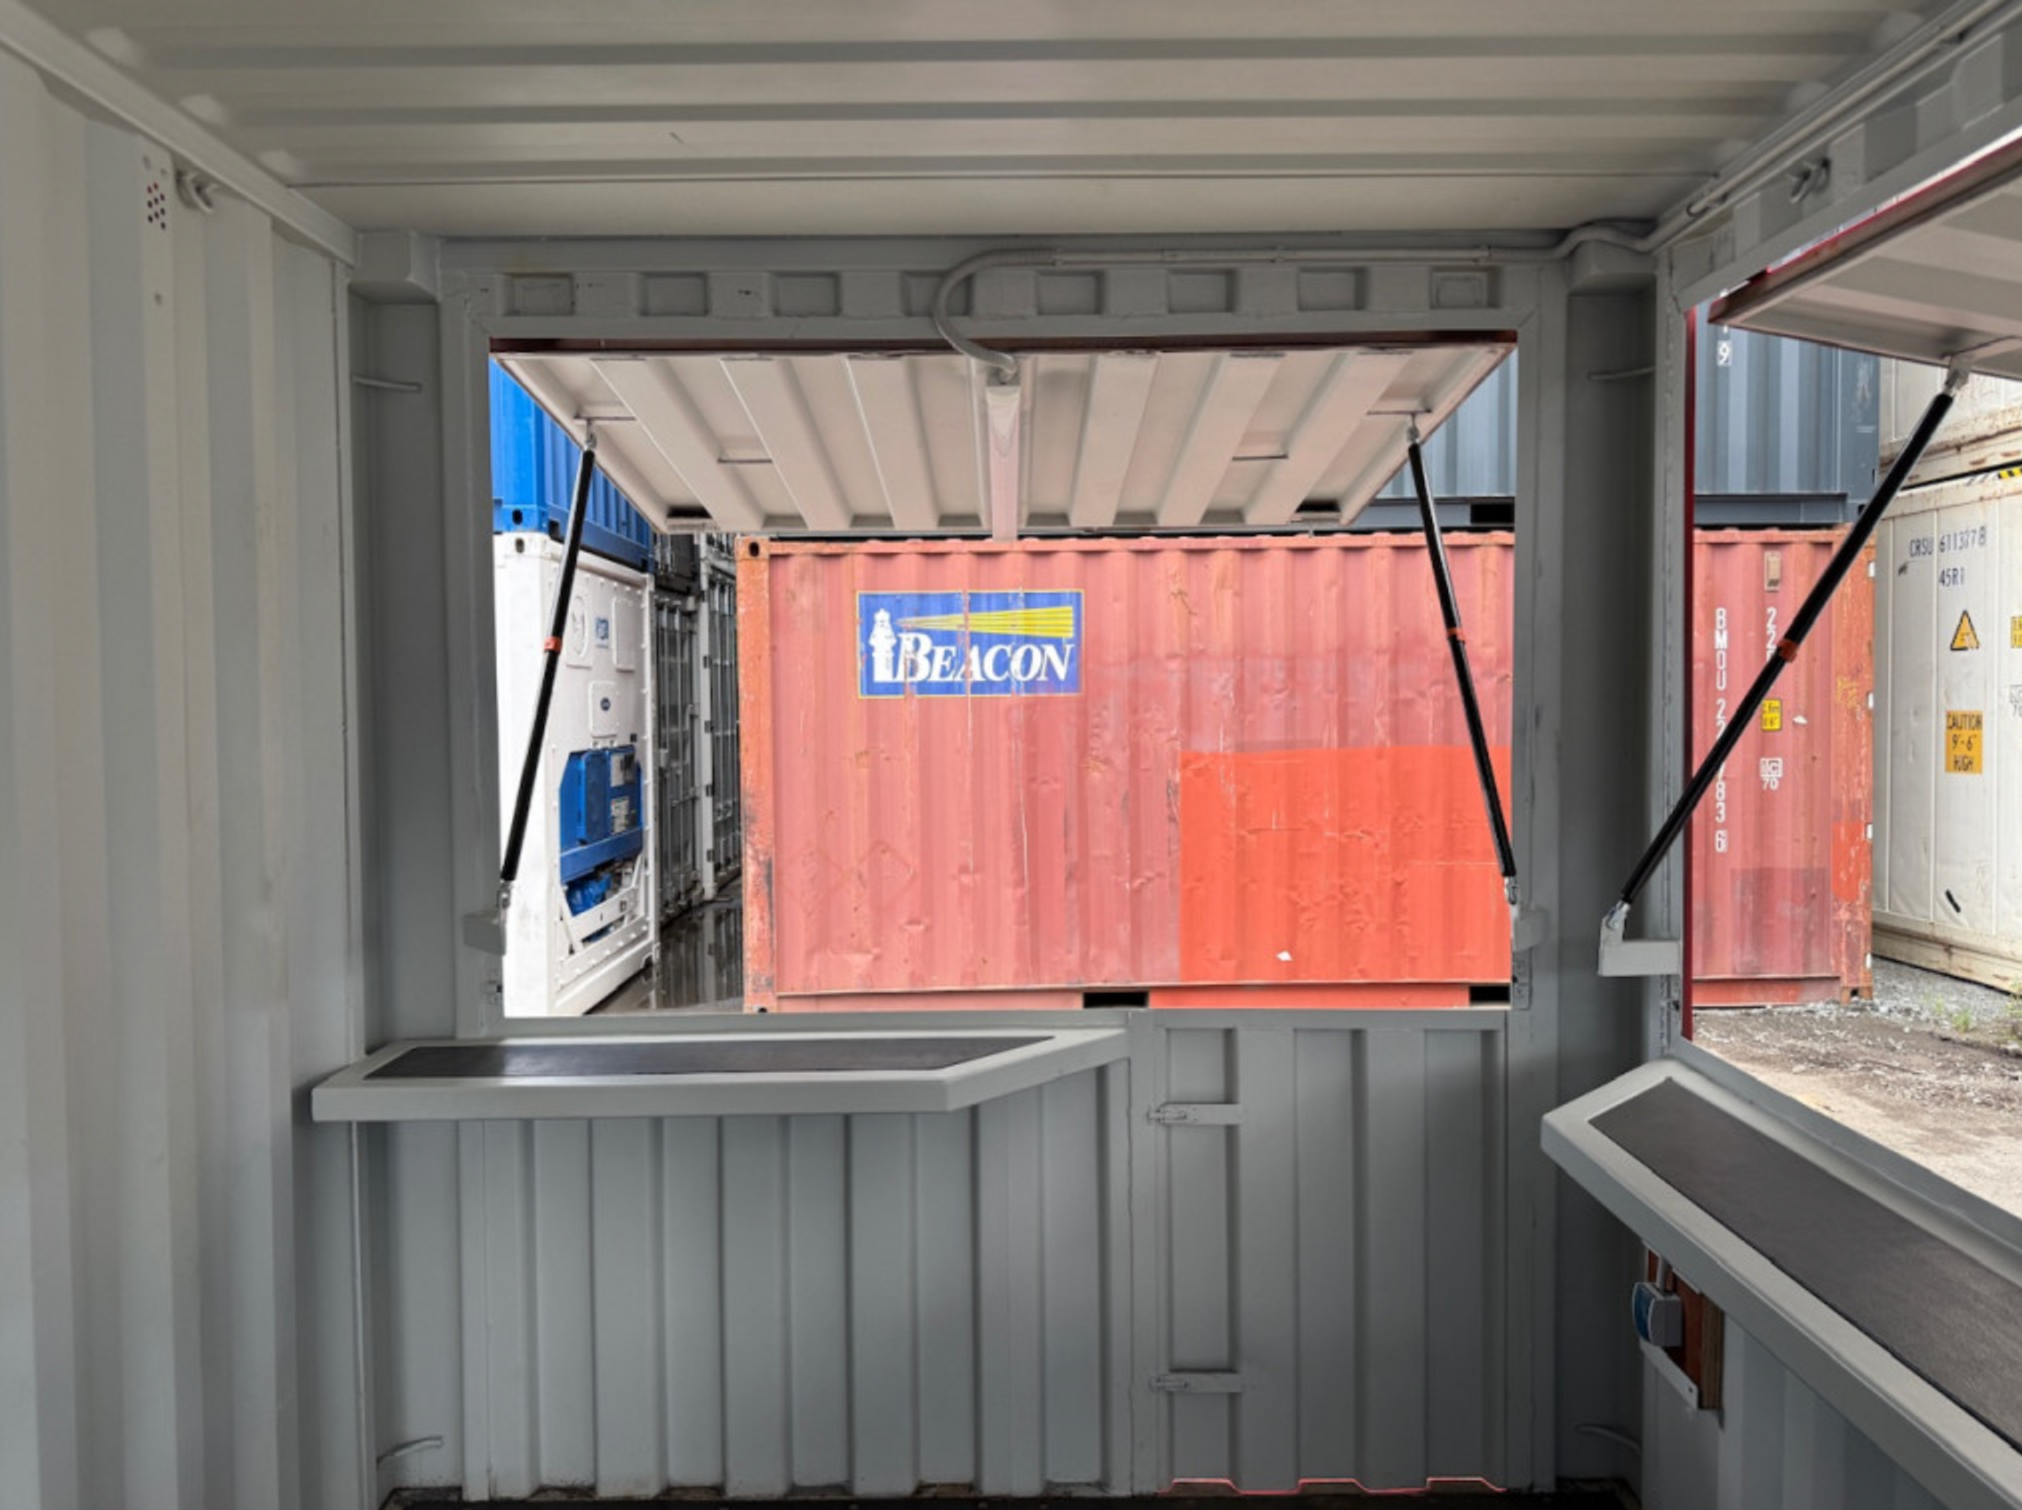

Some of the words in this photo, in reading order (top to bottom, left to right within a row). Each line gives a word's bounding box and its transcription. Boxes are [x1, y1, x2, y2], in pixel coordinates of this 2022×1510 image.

[1910, 538, 1934, 557] CRSU
[894, 632, 1076, 683] BEACON
[1715, 608, 1728, 690] BMOU
[1947, 714, 1983, 731] CAUTION
[1953, 755, 1974, 771] HIGH
[1762, 777, 1779, 791] 70
